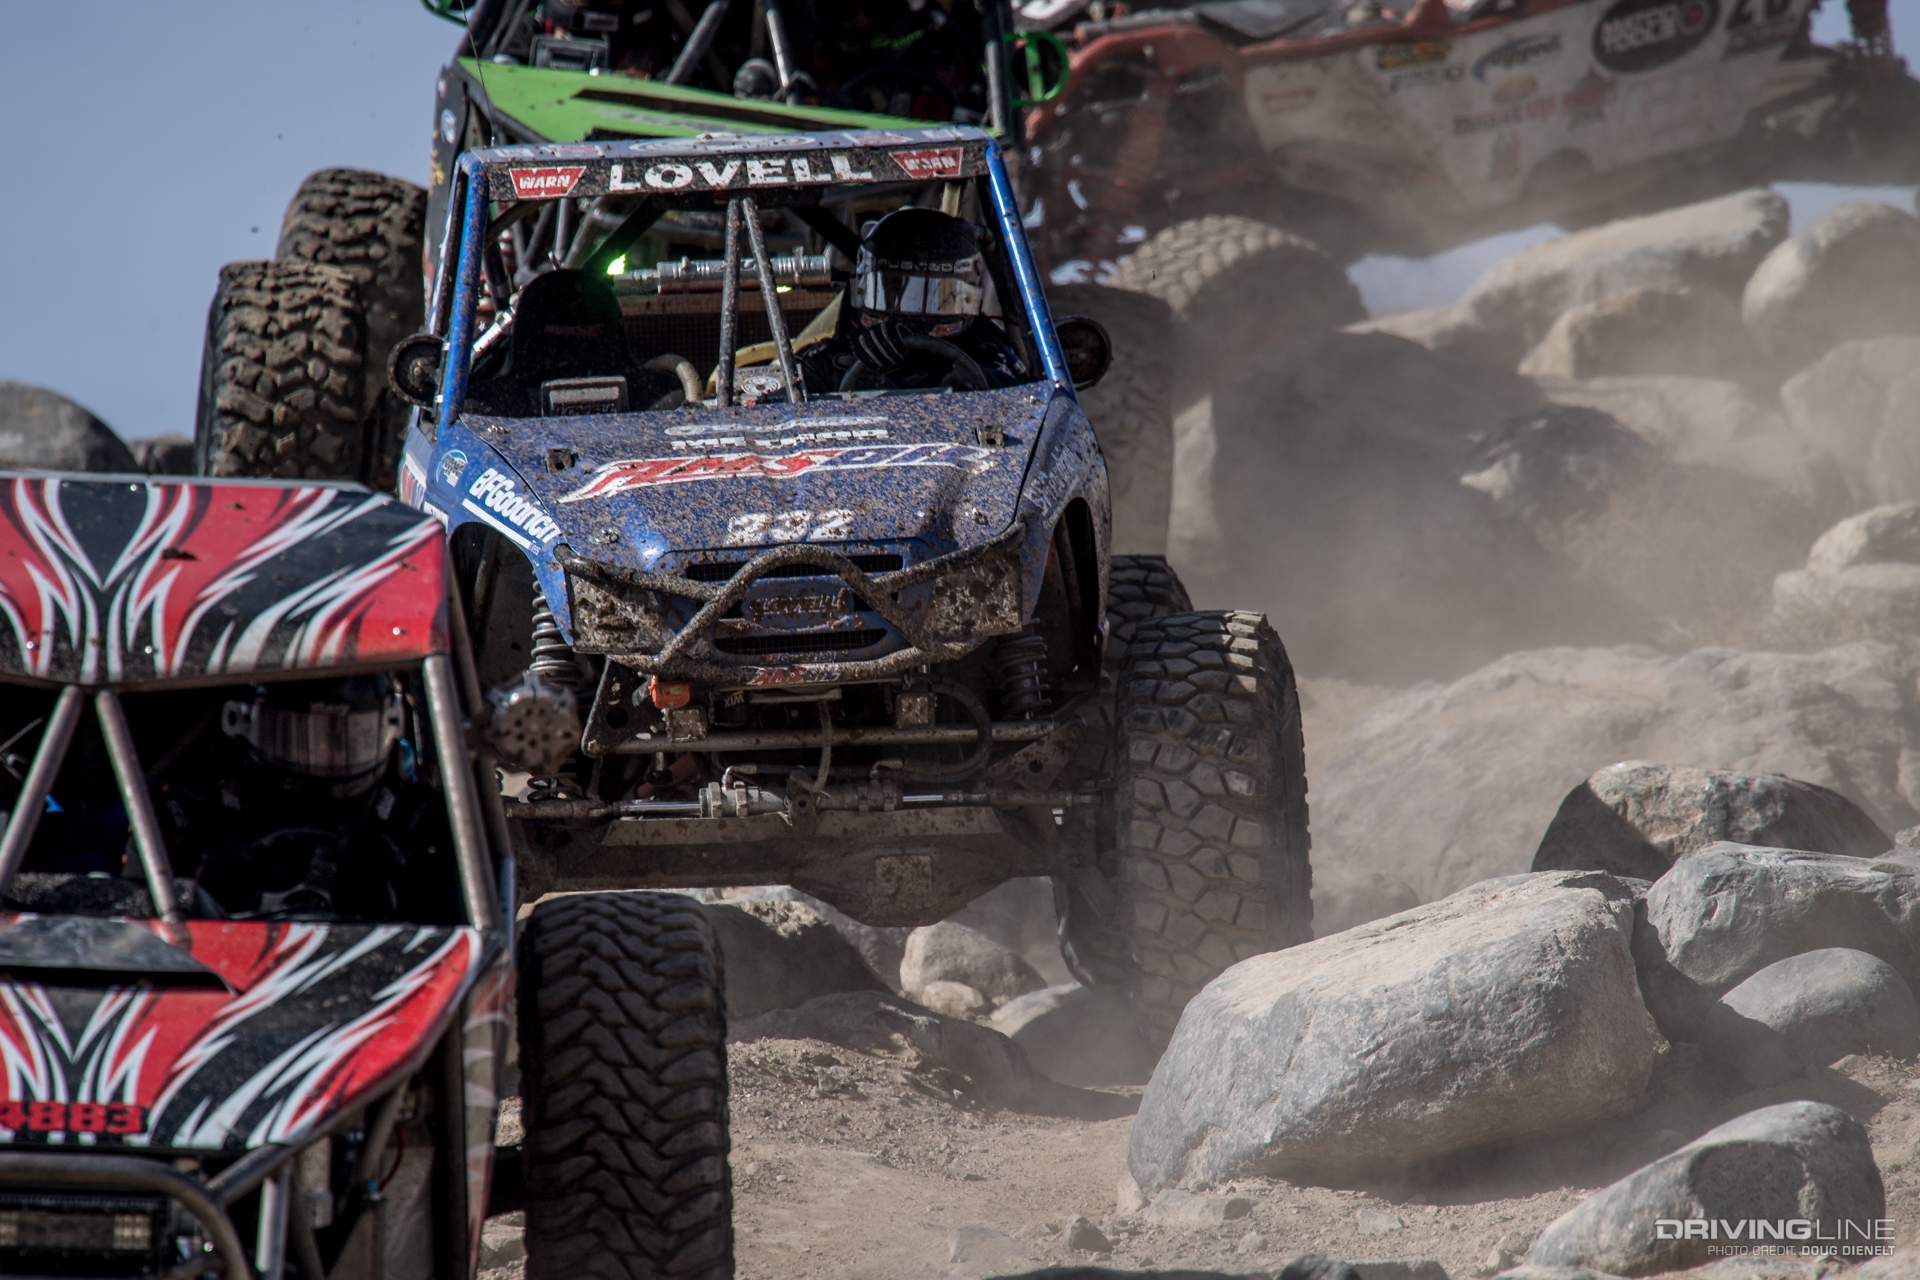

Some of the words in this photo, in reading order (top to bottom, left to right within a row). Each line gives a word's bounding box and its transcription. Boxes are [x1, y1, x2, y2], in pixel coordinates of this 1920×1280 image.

[608, 155, 873, 192] LOVELL
[904, 153, 957, 172] WARN
[518, 175, 572, 193] WARN
[0, 1100, 143, 1134] 4883
